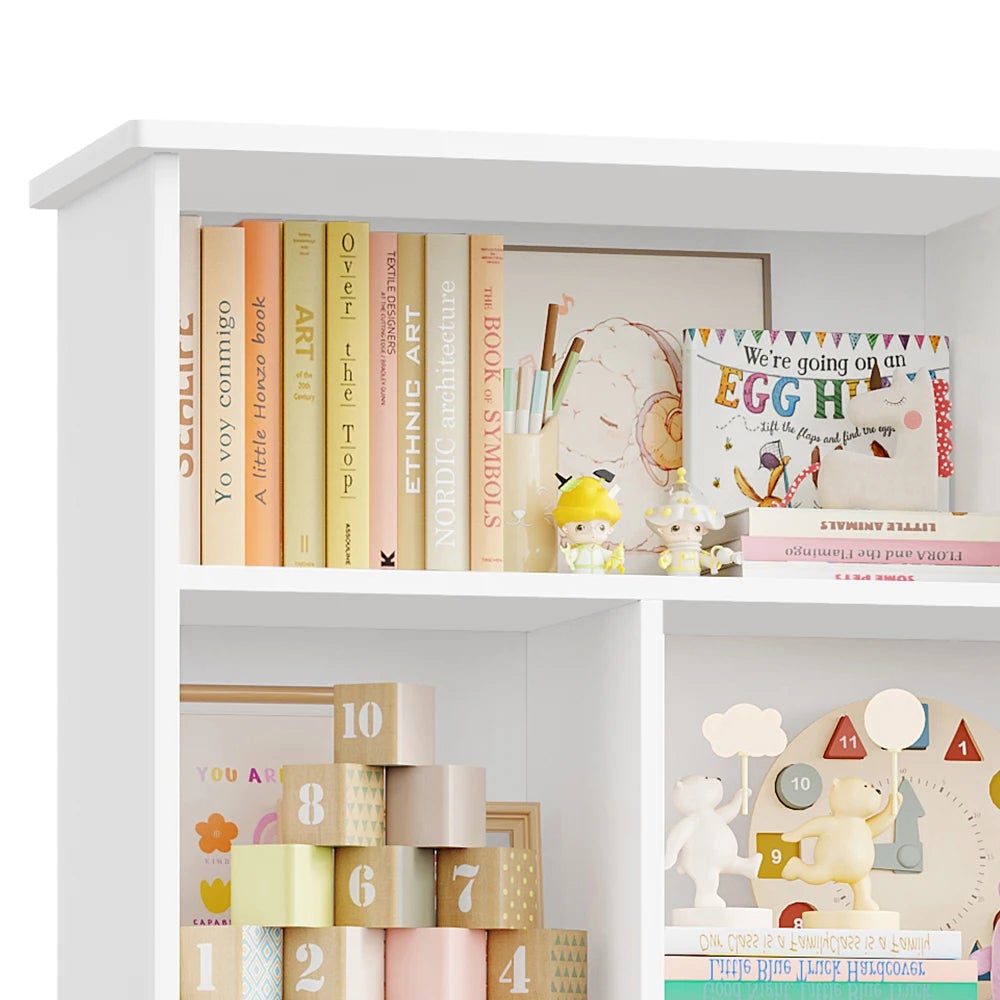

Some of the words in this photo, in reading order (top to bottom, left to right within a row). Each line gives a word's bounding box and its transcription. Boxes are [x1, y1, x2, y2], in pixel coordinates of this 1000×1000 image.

[341, 232, 356, 315] Over
[386, 250, 397, 291] TEXTILE
[252, 296, 266, 344] book
[484, 287, 493, 310] THE
[295, 304, 314, 360] ART
[386, 295, 396, 355] DESIGNERS
[405, 305, 420, 364] ART
[216, 300, 236, 408] conmigo
[435, 280, 456, 428] architecture
[483, 316, 501, 382] BOOK
[744, 345, 791, 369] We're
[797, 357, 849, 376] going
[855, 357, 877, 371] on
[883, 354, 906, 369] an
[253, 354, 267, 419] Honzo
[342, 342, 355, 402] the
[714, 365, 800, 417] EGG
[219, 418, 235, 463] voy
[253, 428, 267, 479] little
[405, 380, 420, 494] ETHNIC
[760, 421, 780, 436] Lift
[782, 420, 796, 434] the
[796, 427, 821, 446] flaps
[823, 432, 843, 444] and
[843, 427, 862, 445] find
[341, 424, 355, 494] Top
[483, 409, 501, 528] SYMBOLS
[215, 471, 233, 505] Yo
[253, 488, 267, 505] A
[435, 438, 456, 547] NORDIC
[820, 520, 884, 532] ANIMALS
[886, 521, 936, 532] LITTLE
[380, 550, 396, 567] K
[785, 546, 853, 559] Flamingo
[857, 548, 881, 560] the
[885, 549, 913, 561] and
[915, 550, 963, 562] FLORA
[342, 700, 383, 739] 10
[839, 736, 858, 749] 11
[958, 741, 968, 756] 1
[195, 766, 238, 783] YOU
[248, 767, 283, 784] AR
[791, 777, 811, 791] 10
[298, 783, 325, 826] 8
[771, 850, 782, 865] 9
[348, 864, 376, 908] 6
[452, 863, 480, 913] 7
[193, 918, 232, 926] CAPAB
[196, 943, 215, 992] 1
[295, 943, 325, 993] 2
[499, 945, 531, 994] 4
